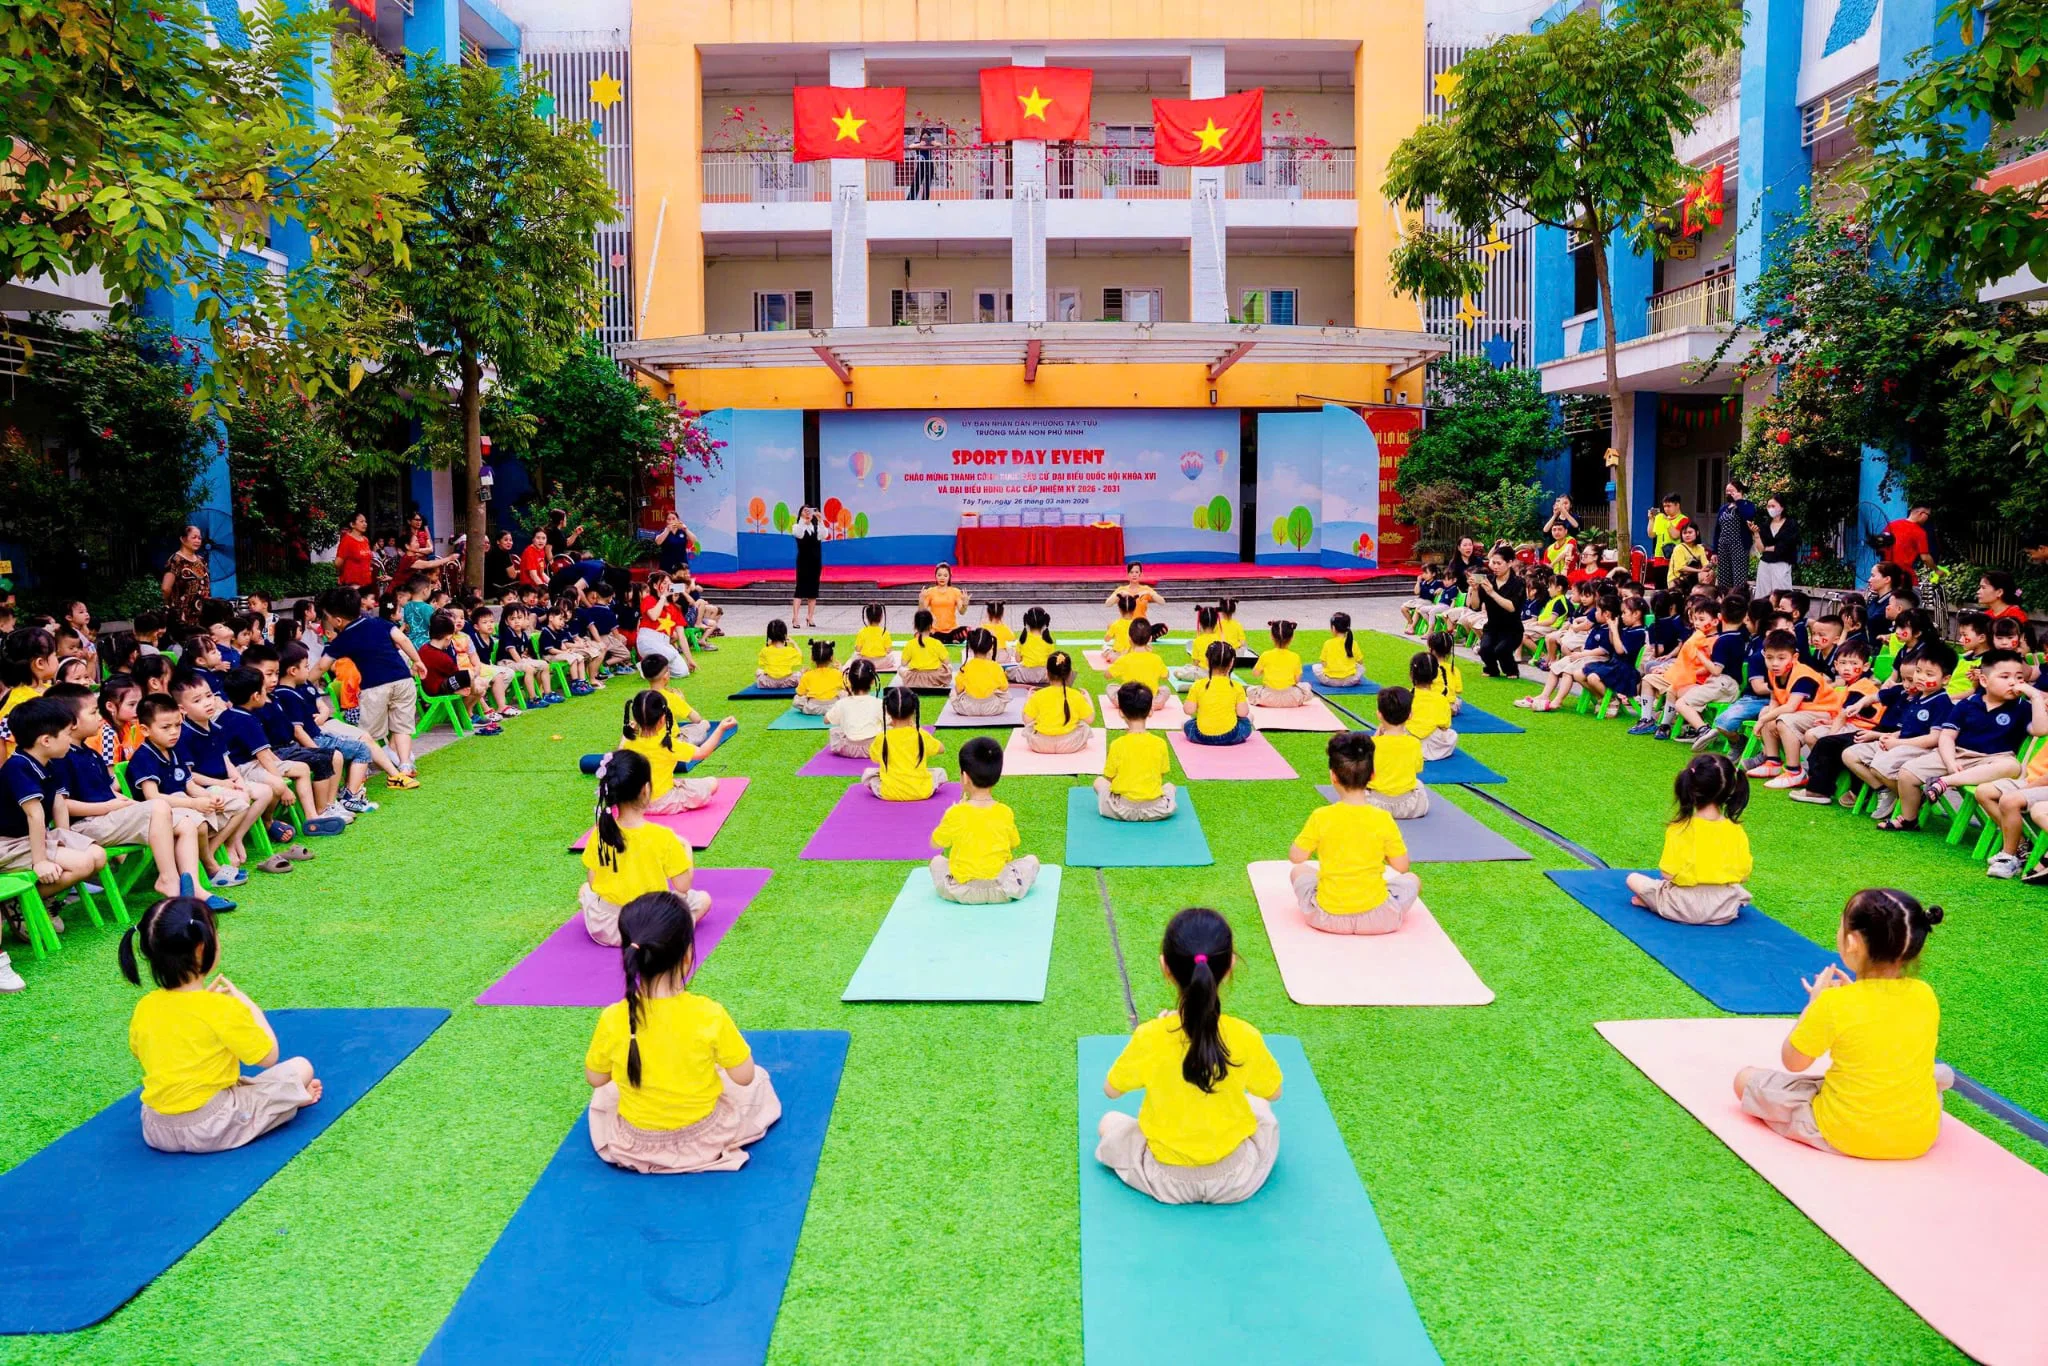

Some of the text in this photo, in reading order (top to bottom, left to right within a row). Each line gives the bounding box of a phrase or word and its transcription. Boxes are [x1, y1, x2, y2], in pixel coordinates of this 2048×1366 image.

[974, 419, 990, 427] BAN
[1066, 418, 1081, 427] TÂY
[1383, 432, 1396, 447] LỢI
[1397, 431, 1410, 445] ÍCH
[951, 449, 1105, 466] SPORT DAY EVENT
[904, 472, 924, 482] CHÀO
[951, 472, 975, 481] THÀNH
[1086, 471, 1106, 481] QUỐC
[1107, 472, 1120, 482] HỘI
[1144, 472, 1157, 481] XVI
[937, 484, 947, 494] VÀ
[1039, 483, 1064, 494] NHIỆM
[1078, 485, 1096, 493] 2026
[1103, 485, 1120, 493] 2031
[963, 498, 975, 506] Tây
